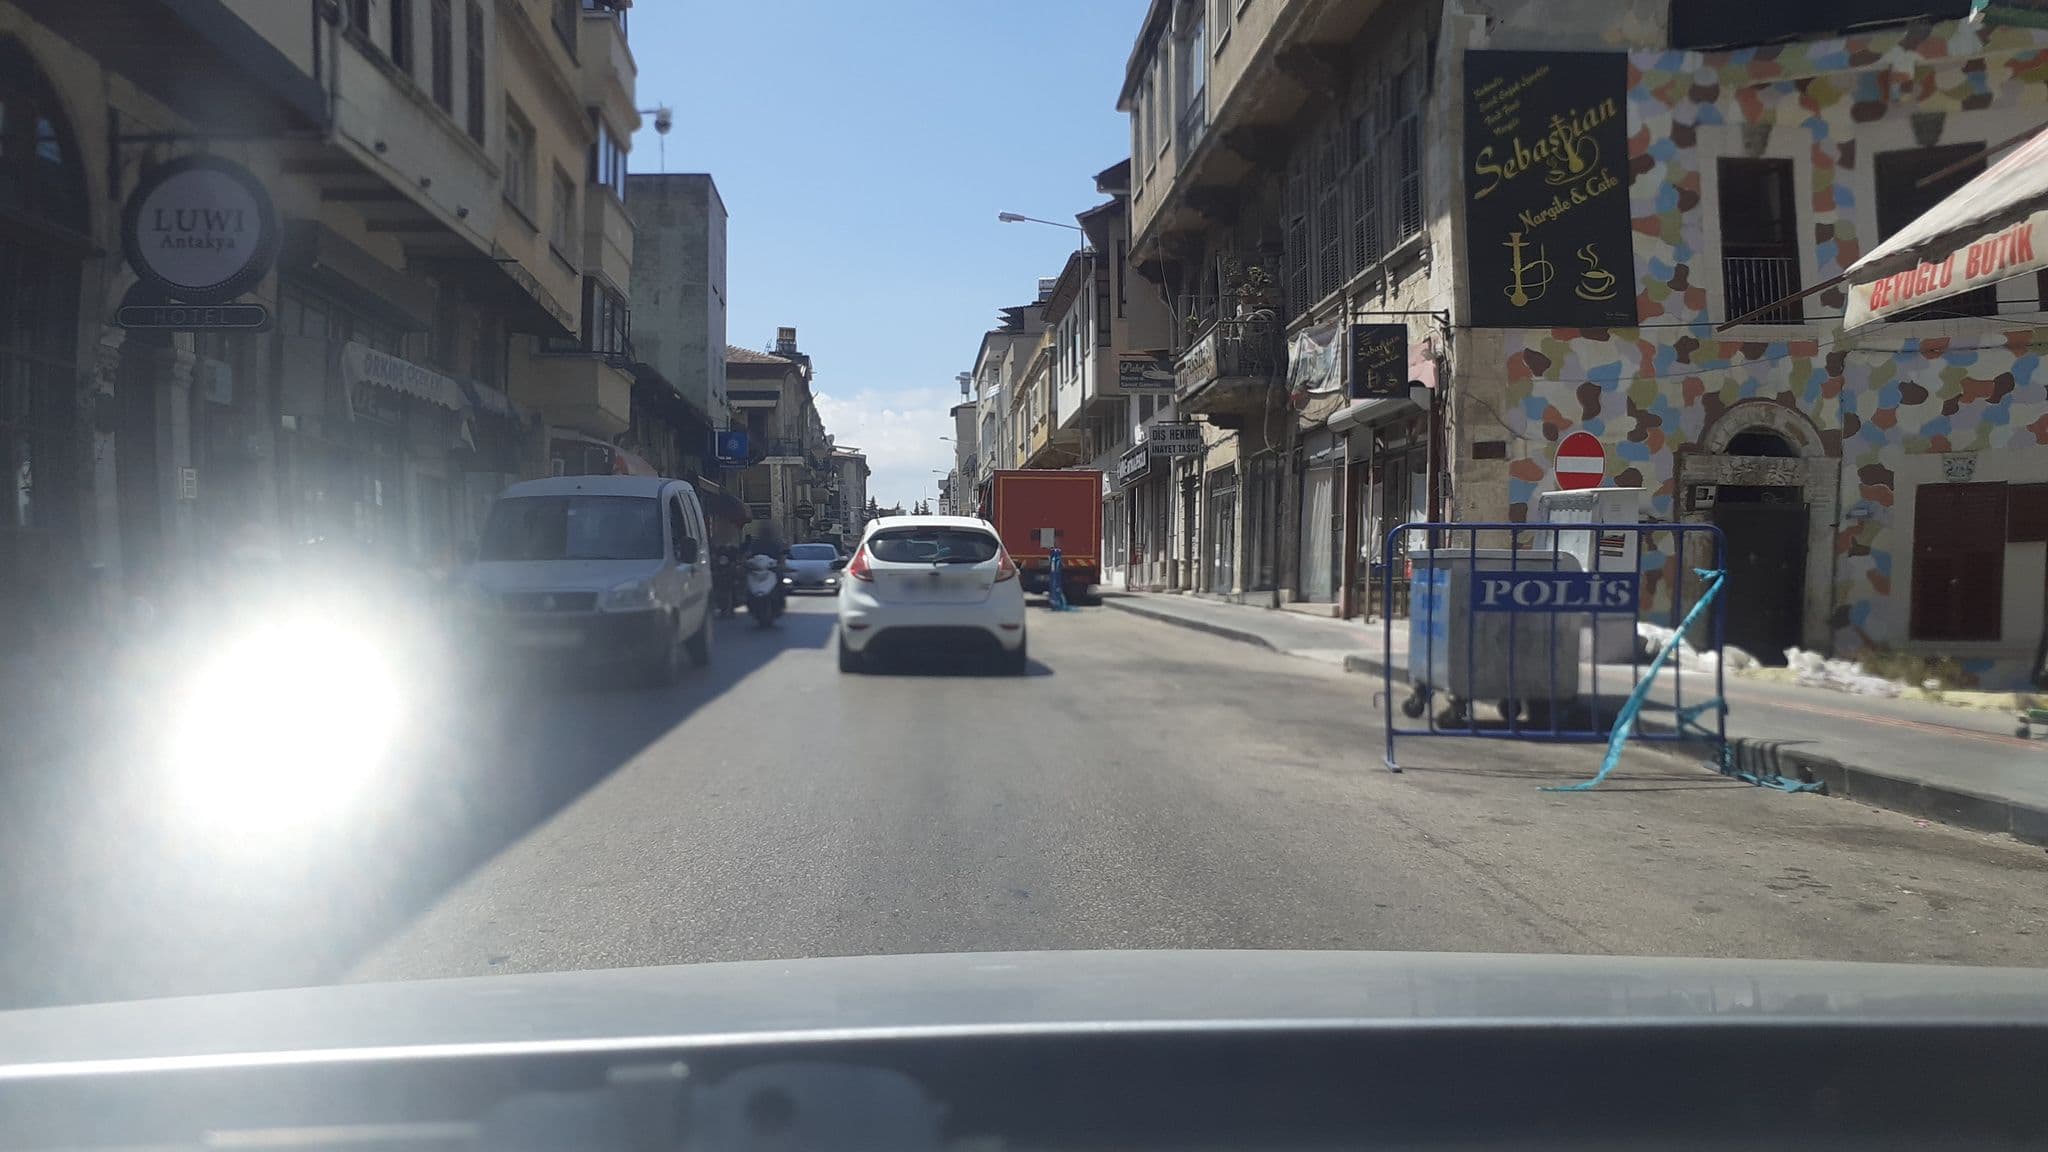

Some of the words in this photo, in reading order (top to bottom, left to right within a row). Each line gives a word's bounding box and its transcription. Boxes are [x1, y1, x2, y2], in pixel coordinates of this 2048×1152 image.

[1473, 98, 1617, 200] Sebastian
[1519, 196, 1570, 235] Nargile
[1571, 188, 1588, 205] &
[1586, 168, 1617, 196] Cafe
[153, 209, 245, 233] LUWI
[161, 235, 236, 253] Antakya
[154, 309, 226, 324] HOTEL
[1480, 574, 1631, 606] POLİS
